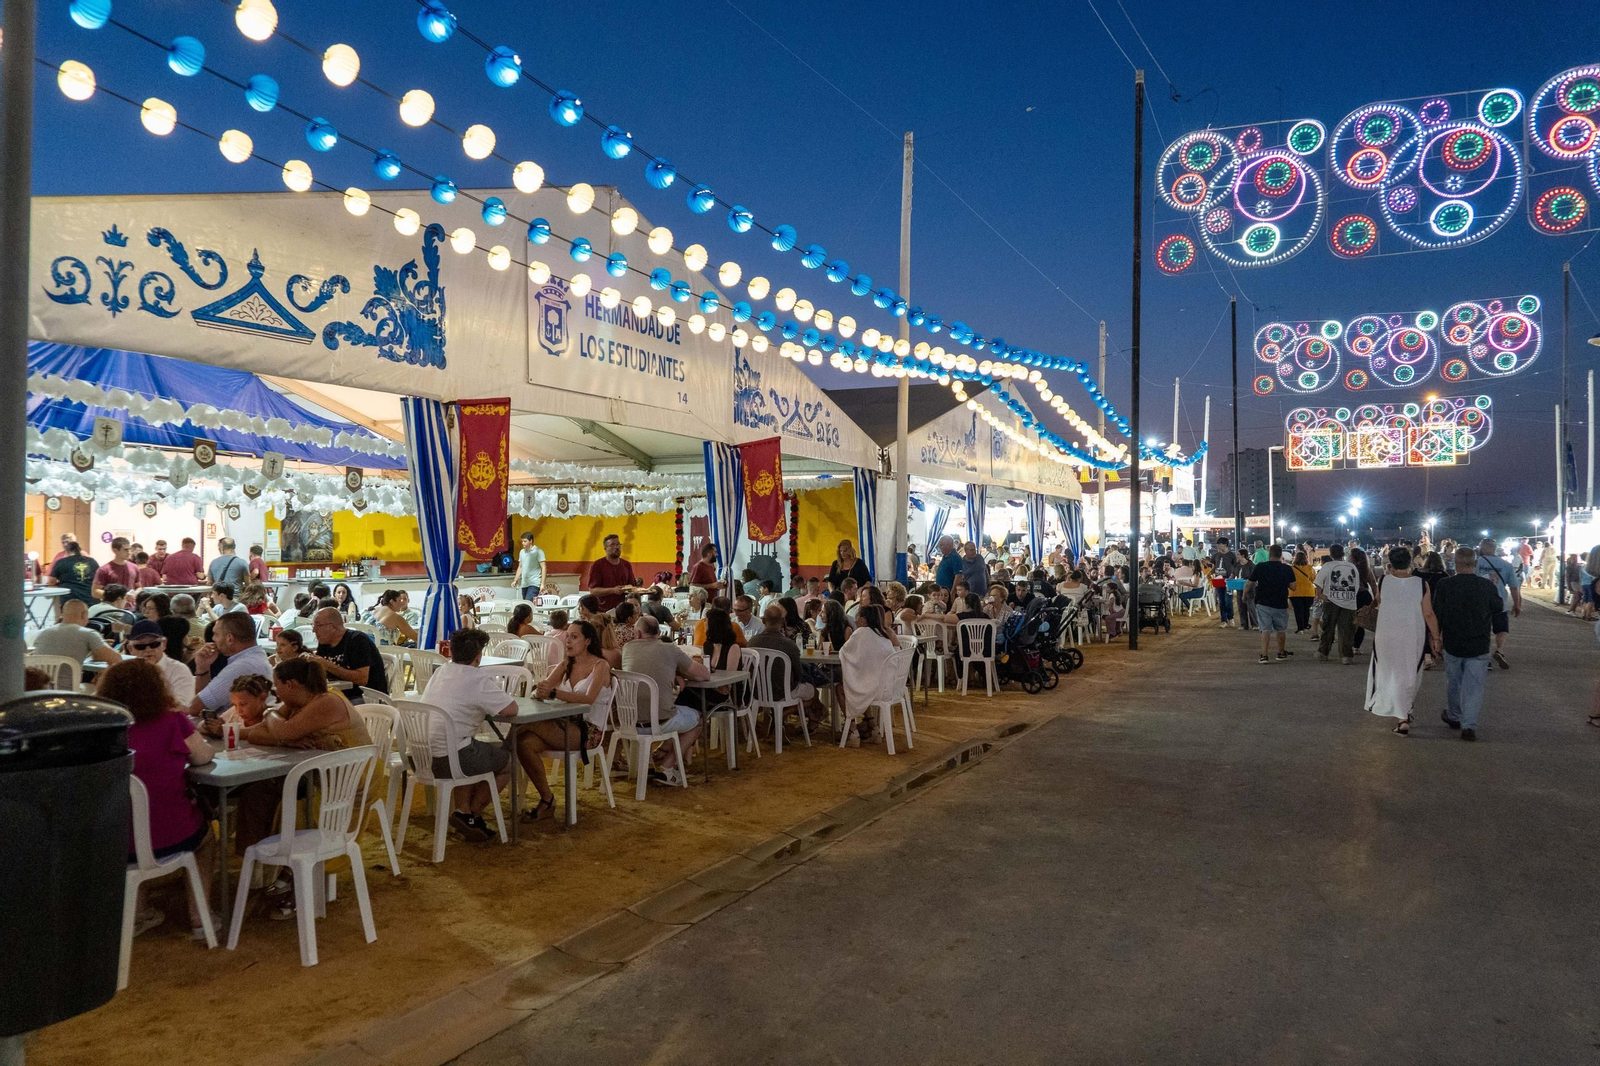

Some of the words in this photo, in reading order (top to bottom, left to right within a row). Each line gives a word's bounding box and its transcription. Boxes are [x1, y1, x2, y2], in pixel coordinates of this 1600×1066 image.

[585, 294, 664, 340] HERMANDAD
[667, 323, 681, 345] DE
[580, 332, 605, 362] LOS
[608, 340, 685, 382] ESTUDIANTES
[677, 391, 688, 404] 14
